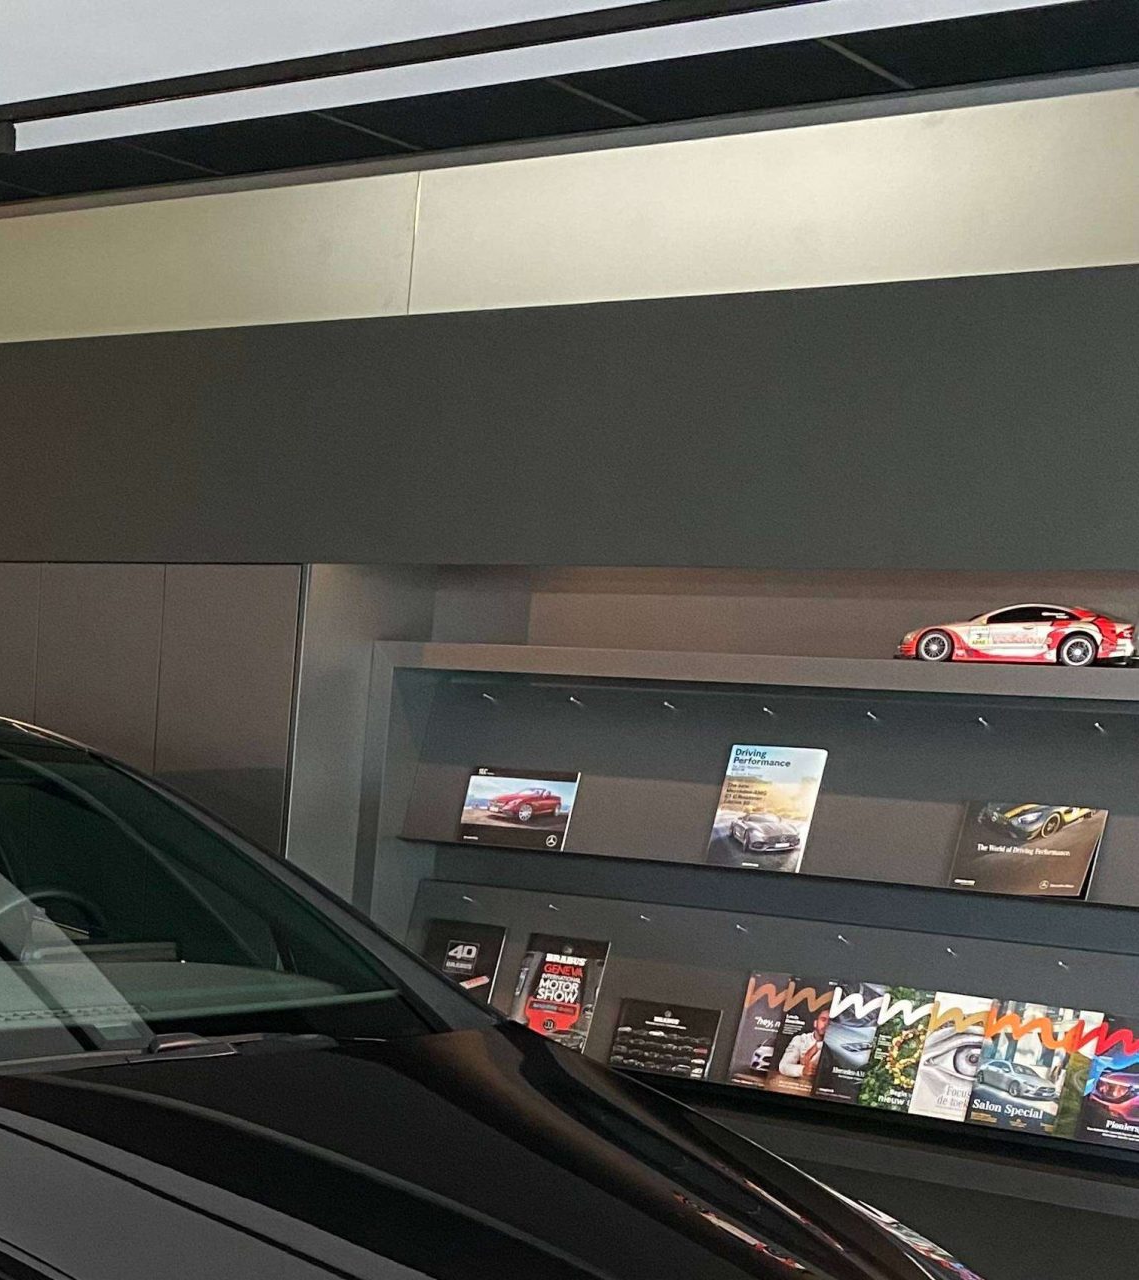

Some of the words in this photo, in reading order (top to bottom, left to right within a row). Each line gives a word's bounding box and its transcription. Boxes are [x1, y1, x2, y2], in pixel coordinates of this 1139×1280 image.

[735, 748, 767, 759] Driving
[733, 757, 791, 767] Performance
[977, 843, 988, 851] The
[989, 845, 1007, 853] World
[1013, 847, 1034, 856] Driving
[545, 953, 587, 966] BRABUS
[544, 963, 583, 977] GENEVA
[539, 978, 579, 993] MOTOR
[536, 988, 579, 1004] SHOW
[972, 1099, 1002, 1113] Salon
[1004, 1104, 1044, 1119] Special
